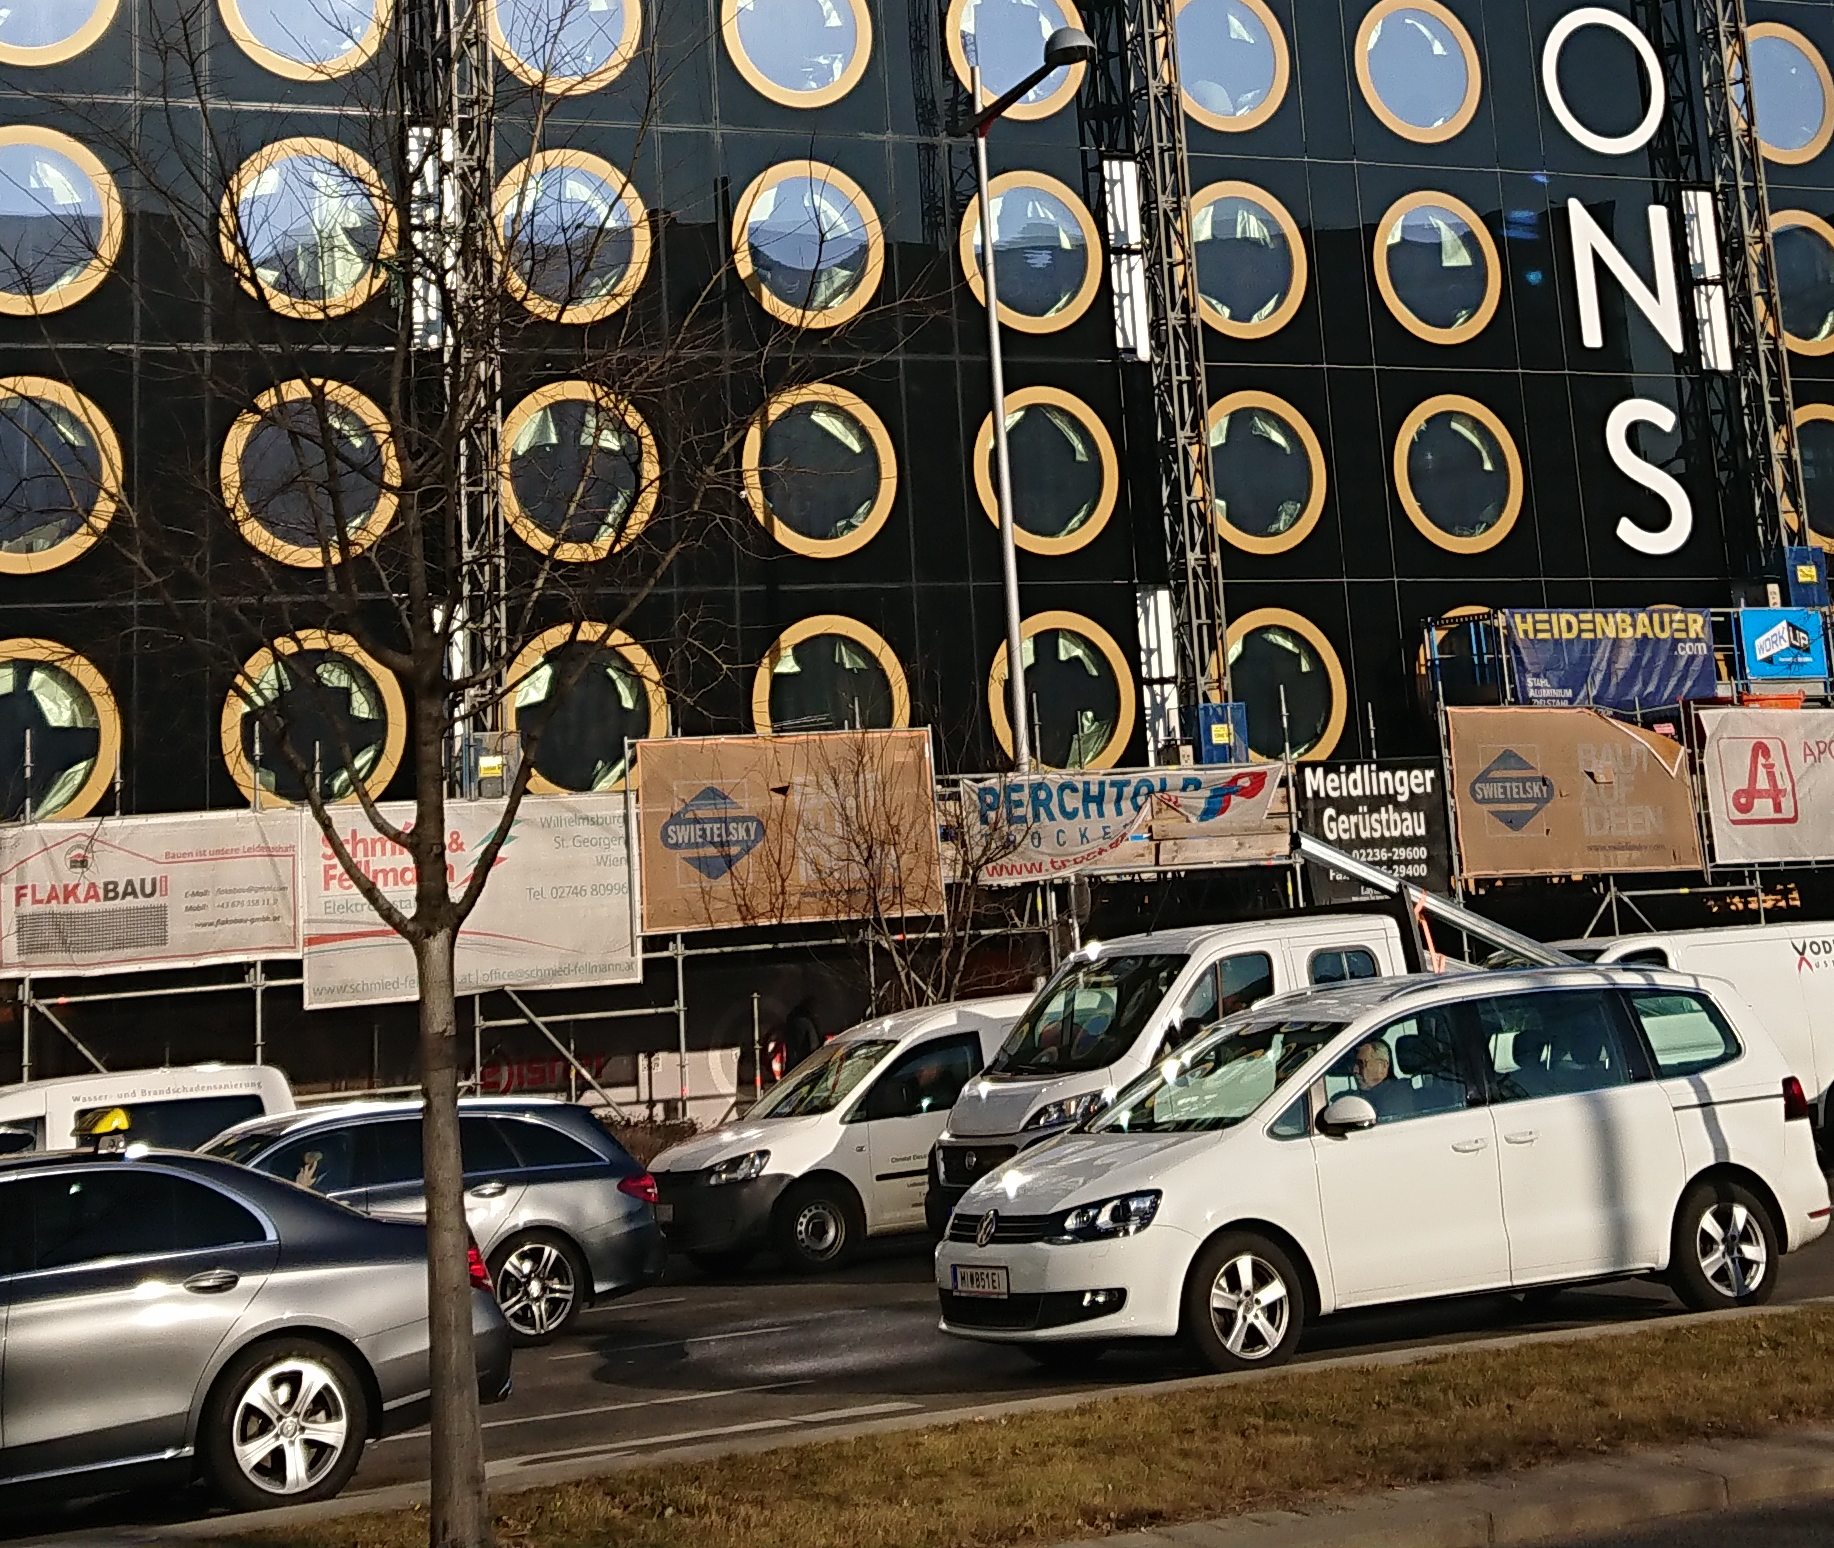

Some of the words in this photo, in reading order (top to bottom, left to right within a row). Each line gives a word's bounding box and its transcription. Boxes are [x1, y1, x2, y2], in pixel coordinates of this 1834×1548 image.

[1513, 612, 1706, 640] HEIDENBAUER
[1674, 641, 1708, 656] .com
[1756, 626, 1787, 655] WORK
[1789, 626, 1809, 649] UP
[1526, 677, 1551, 688] STAHL
[1529, 688, 1573, 698] ALUMINIUM
[1577, 742, 1649, 774] BAUT
[1304, 763, 1436, 803] Meidlinger
[1474, 781, 1549, 800] SWIETELSKY
[1579, 772, 1636, 804] AUF
[1322, 804, 1427, 841] Gerüstbau
[1582, 805, 1664, 837] IDEEN
[448, 830, 466, 853] &
[553, 835, 569, 850] St.
[666, 821, 758, 845] SWIETELSKY
[164, 851, 194, 860] Bauen
[195, 849, 207, 857] ist
[209, 846, 240, 856] unsere
[242, 842, 296, 853] Leidenschaft
[595, 854, 627, 867] Wien
[1352, 846, 1428, 862] 02236-29600
[14, 876, 158, 908] FLAKABAU
[550, 884, 587, 900] 02746
[590, 882, 629, 897] 80996
[482, 960, 635, 984] office@schmied-fellmann.at
[116, 1089, 137, 1100] und
[140, 1079, 263, 1097] Brandschadensanierung
